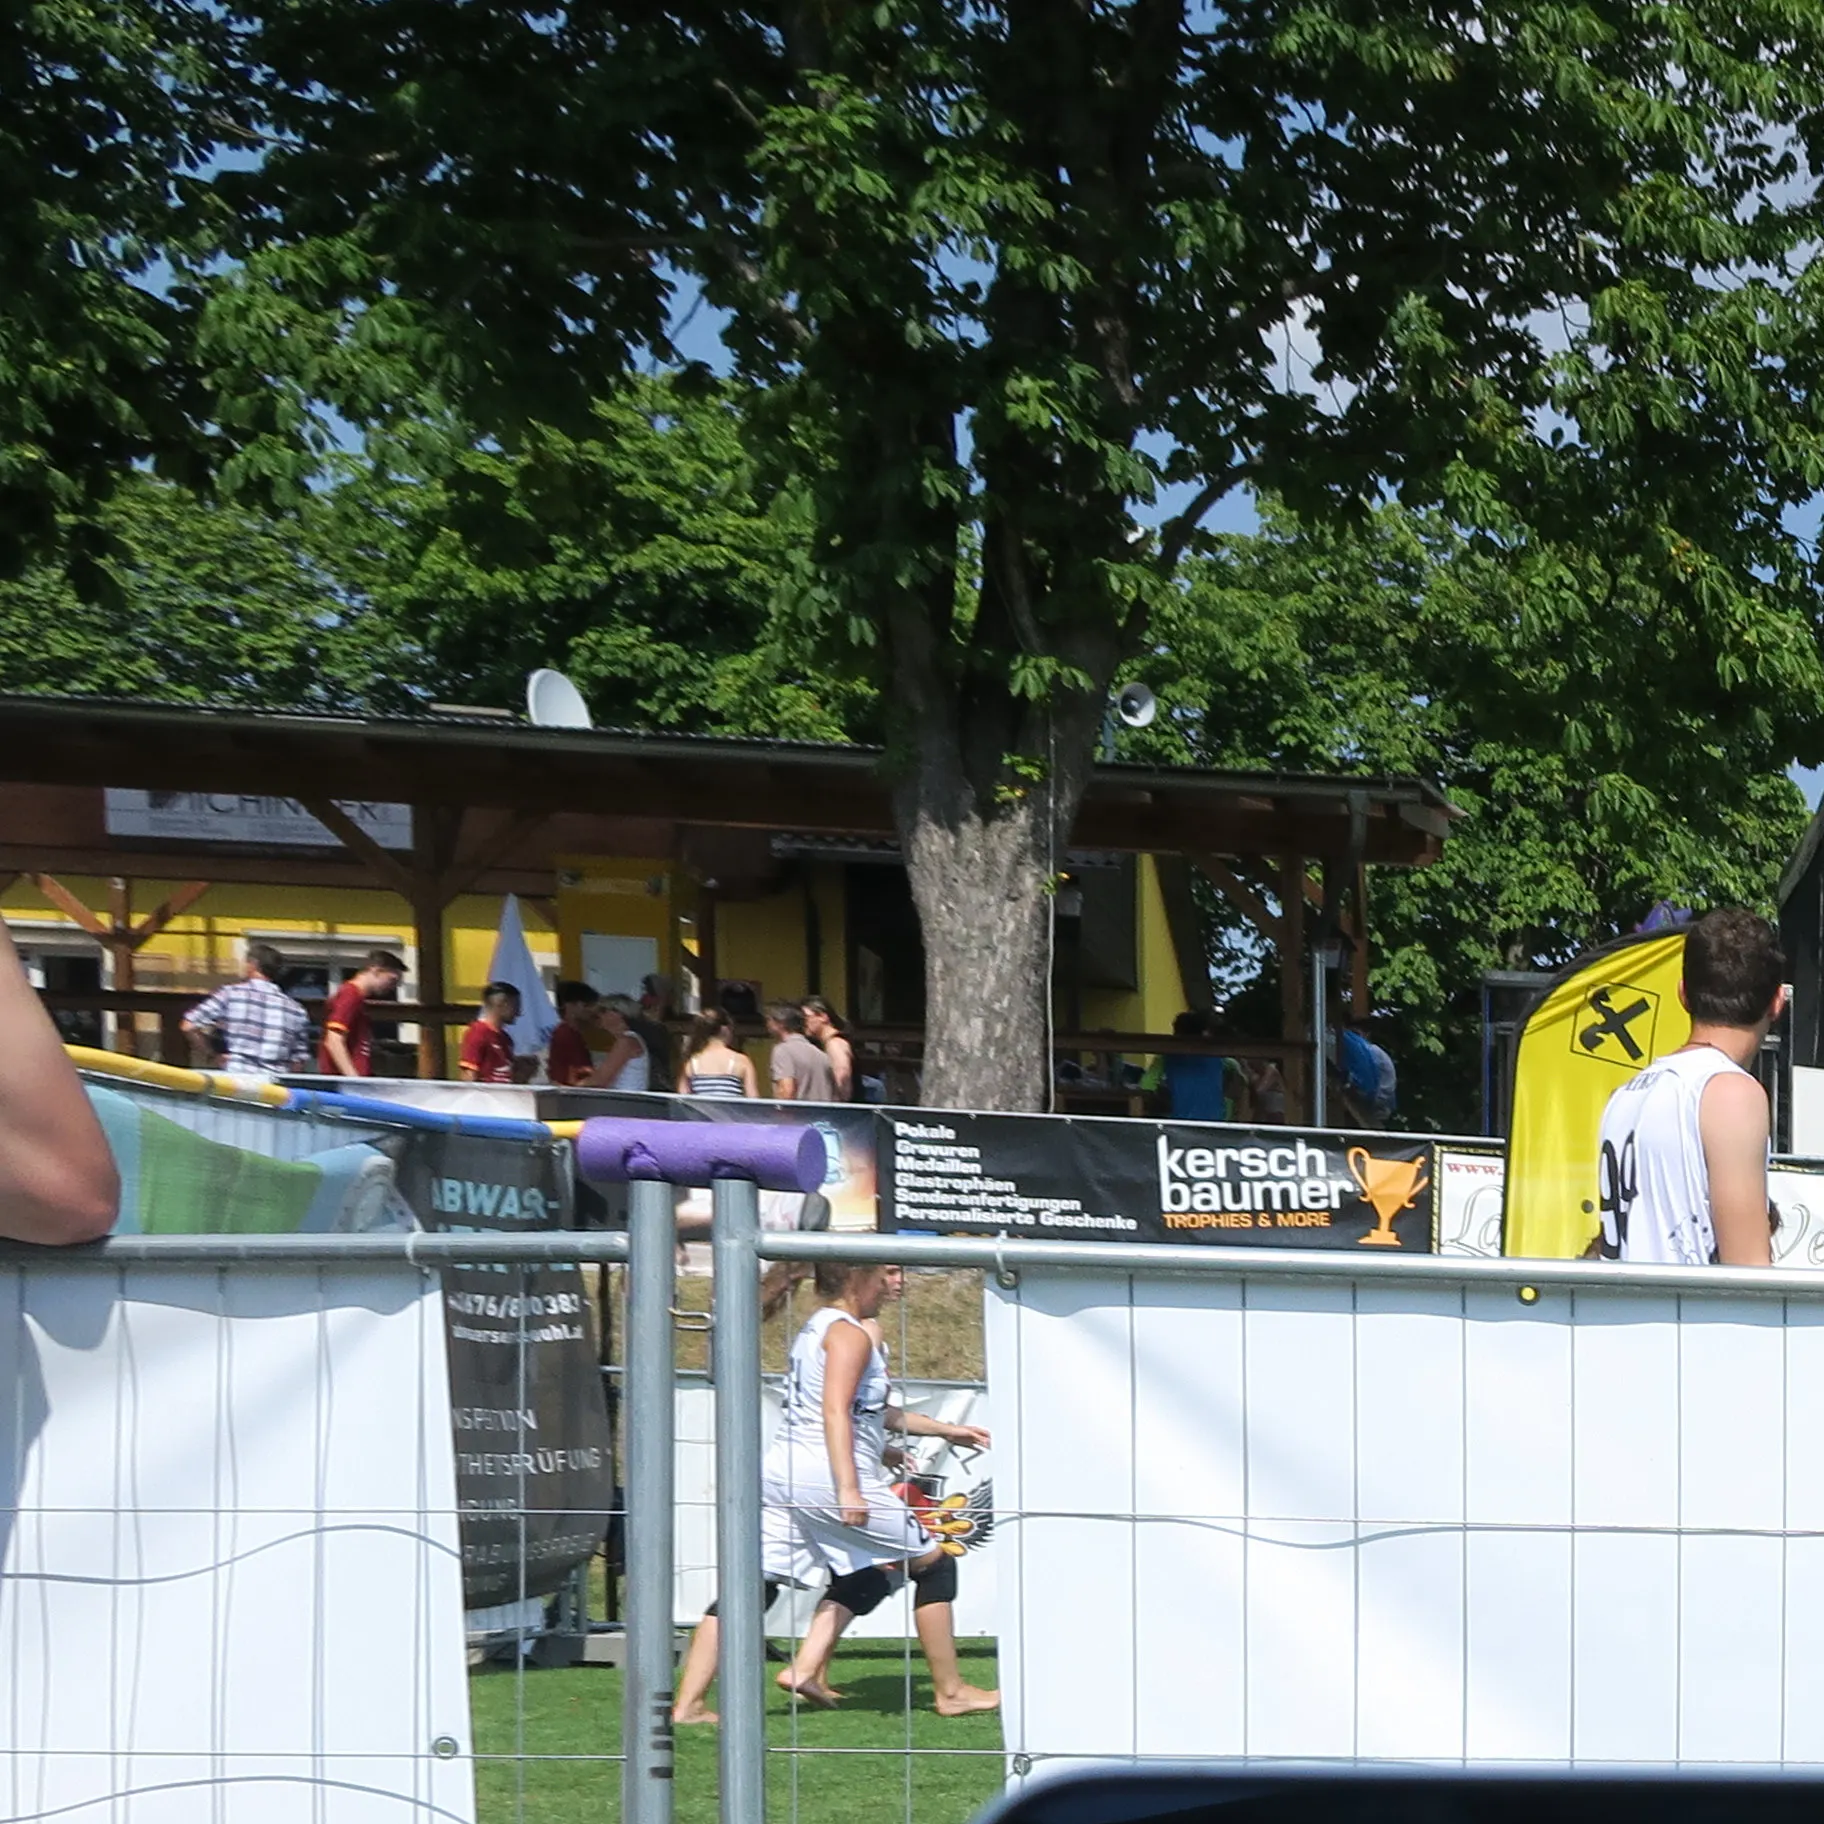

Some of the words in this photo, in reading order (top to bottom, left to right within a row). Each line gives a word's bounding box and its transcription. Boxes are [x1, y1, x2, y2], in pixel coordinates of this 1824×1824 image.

[895, 1121, 956, 1140] Pokale
[895, 1139, 980, 1158] Gravuren
[1157, 1135, 1327, 1179] kersch
[895, 1155, 982, 1174] Medaillen
[895, 1172, 1016, 1194] Glastrophäen
[895, 1188, 1081, 1213] Sonderanfertigungen
[1160, 1177, 1354, 1213] baumer
[895, 1204, 1036, 1225] Personalisierte
[1039, 1211, 1138, 1231] Geschenke
[1163, 1212, 1253, 1230] TROPHIES
[1258, 1213, 1272, 1228] &
[1276, 1212, 1332, 1229] MORE
